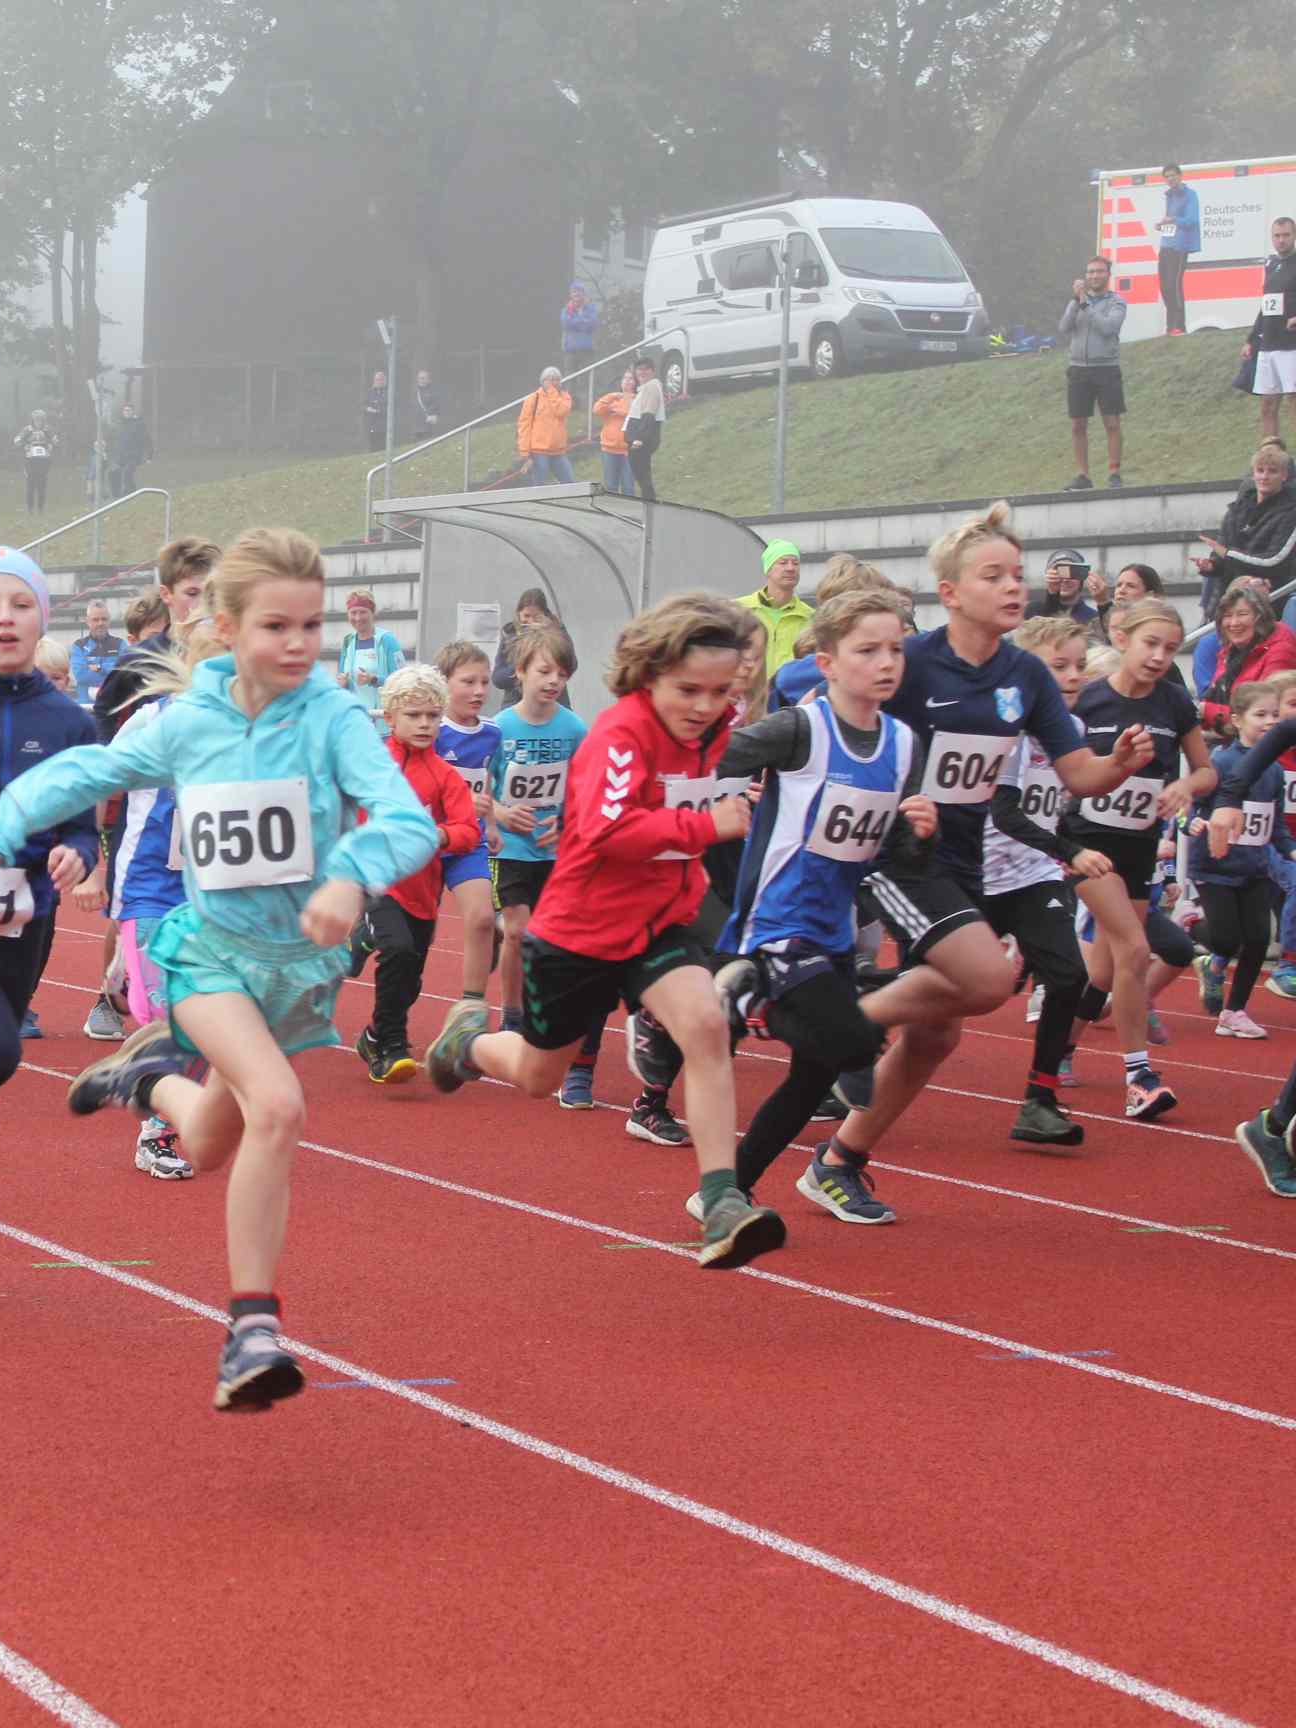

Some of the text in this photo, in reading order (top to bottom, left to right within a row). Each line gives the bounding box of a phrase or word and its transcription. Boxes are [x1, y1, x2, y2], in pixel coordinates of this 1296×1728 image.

[509, 773, 562, 799] 627
[936, 751, 1005, 790] 604
[190, 806, 296, 868] 650
[823, 804, 890, 848] 644
[1241, 813, 1271, 837] 51
